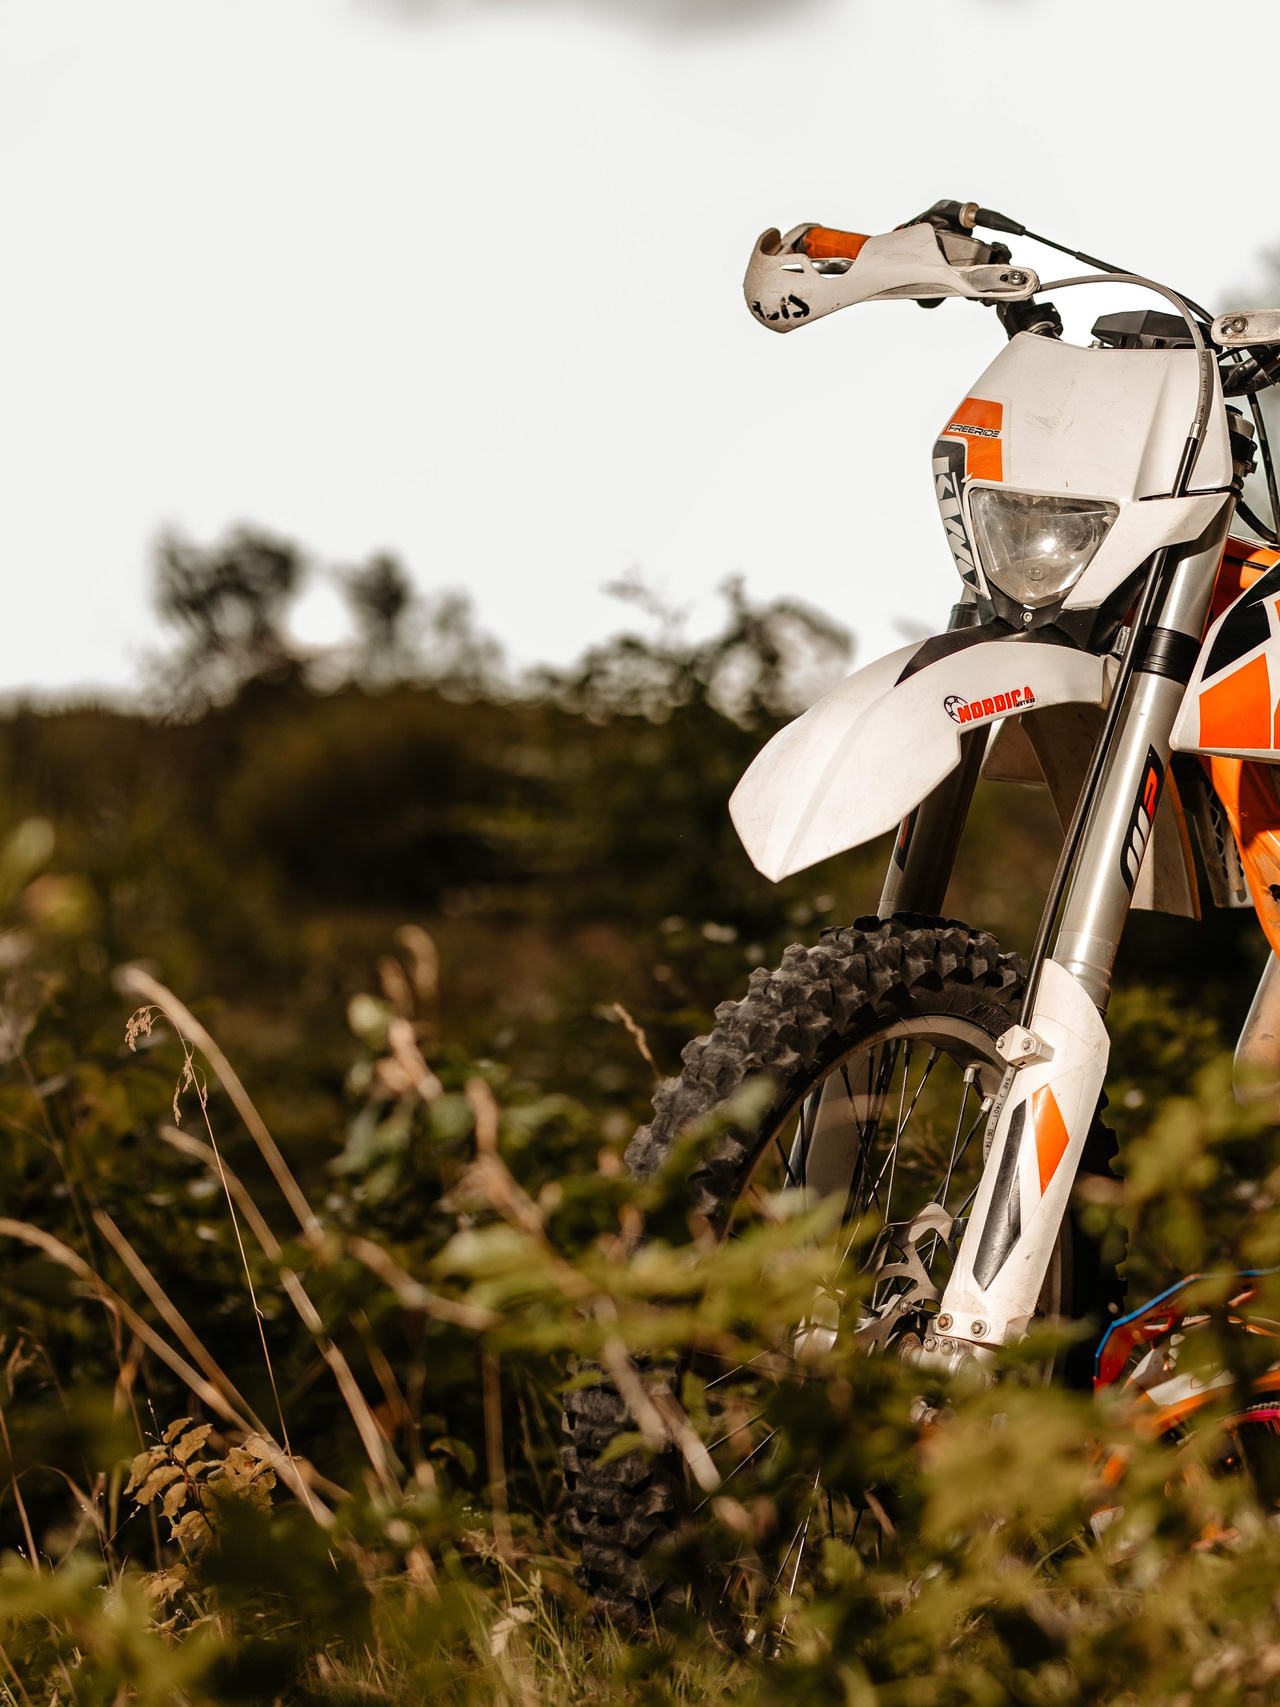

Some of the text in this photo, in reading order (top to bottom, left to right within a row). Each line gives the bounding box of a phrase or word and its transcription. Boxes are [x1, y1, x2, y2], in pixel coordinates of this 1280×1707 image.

[948, 423, 1001, 438] FREERIDE
[957, 686, 1035, 724] NORDICA
[1002, 1077, 1012, 1091] SAE
[993, 1102, 1002, 1118] 1401
[985, 1128, 994, 1148] 06/14
